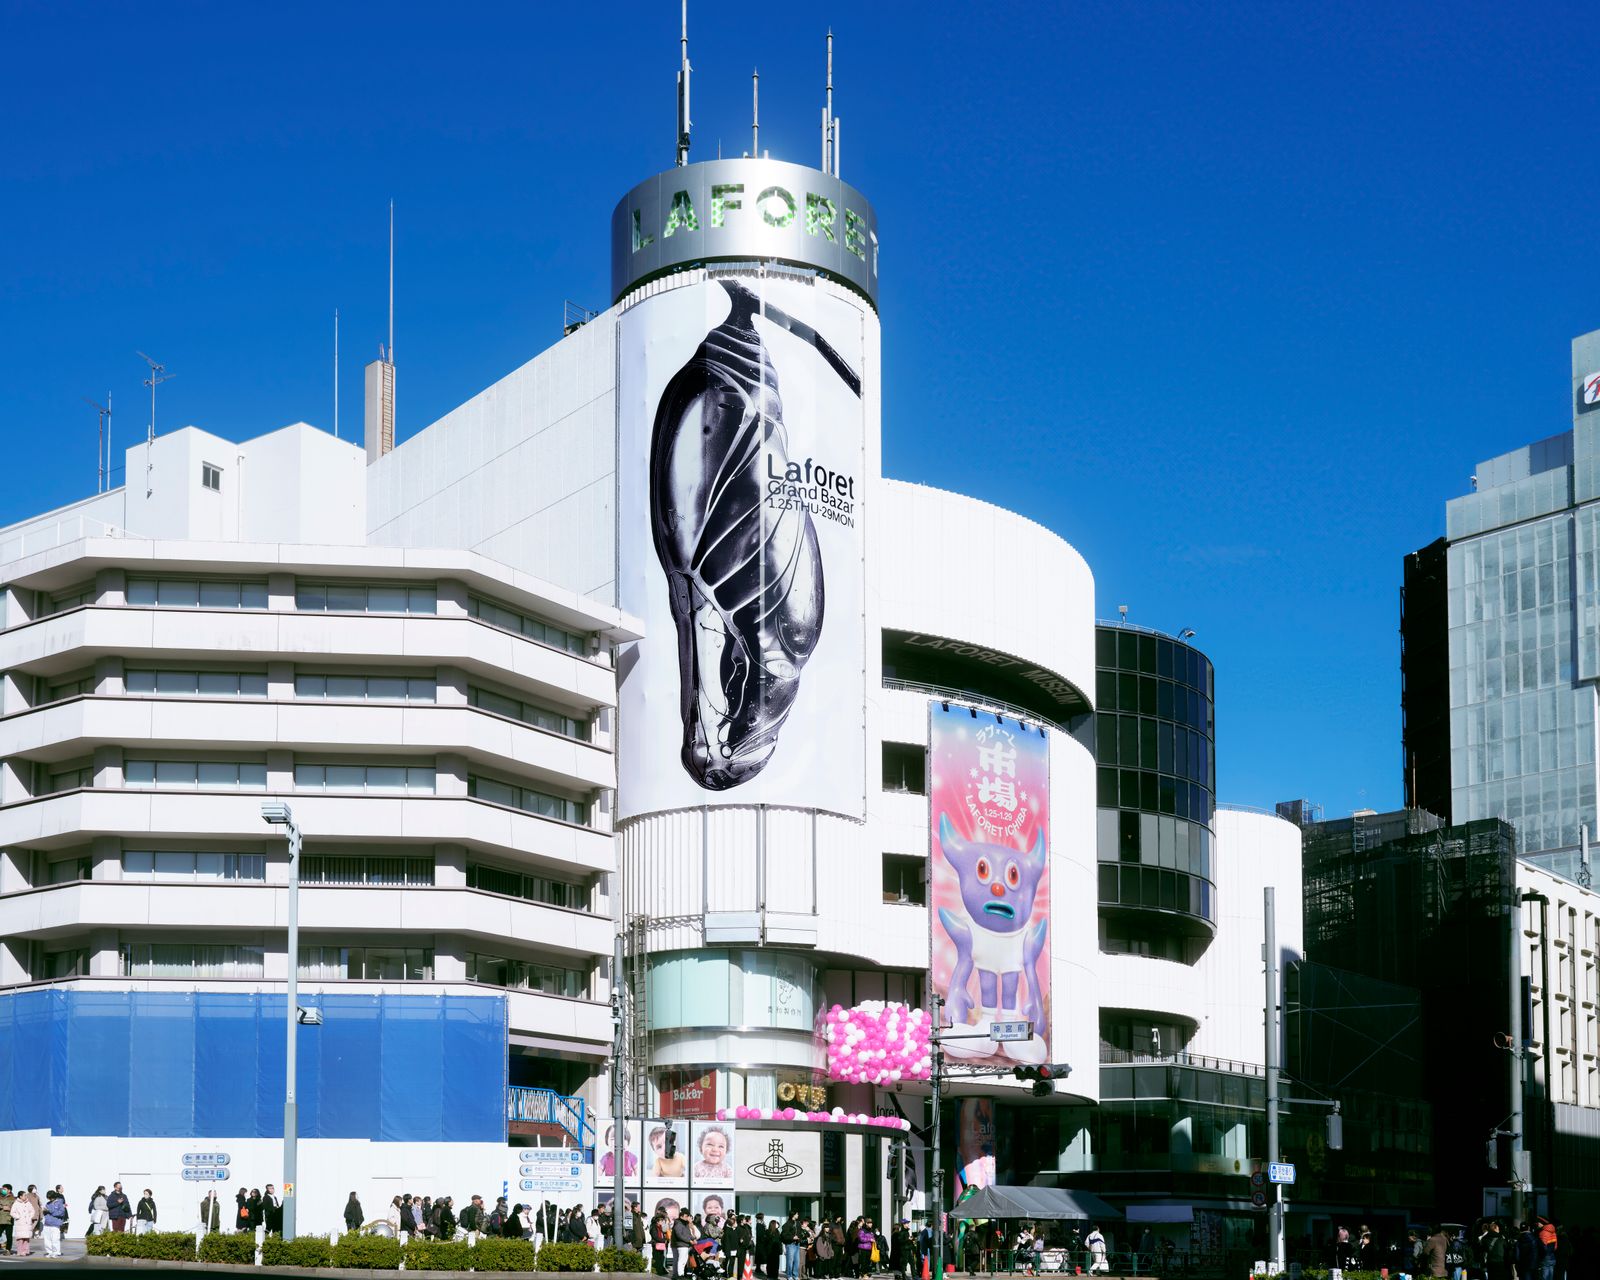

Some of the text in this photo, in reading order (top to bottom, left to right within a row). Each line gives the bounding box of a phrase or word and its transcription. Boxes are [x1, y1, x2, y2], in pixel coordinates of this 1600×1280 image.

[767, 453, 855, 499] Laforet
[768, 480, 855, 514] Grand Bazar
[904, 635, 1081, 705] LAFORET MUSEUM
[966, 795, 1028, 837] LAFORET ICHIBA
[993, 1023, 1025, 1033] 神宮前
[673, 1088, 704, 1101] Baker
